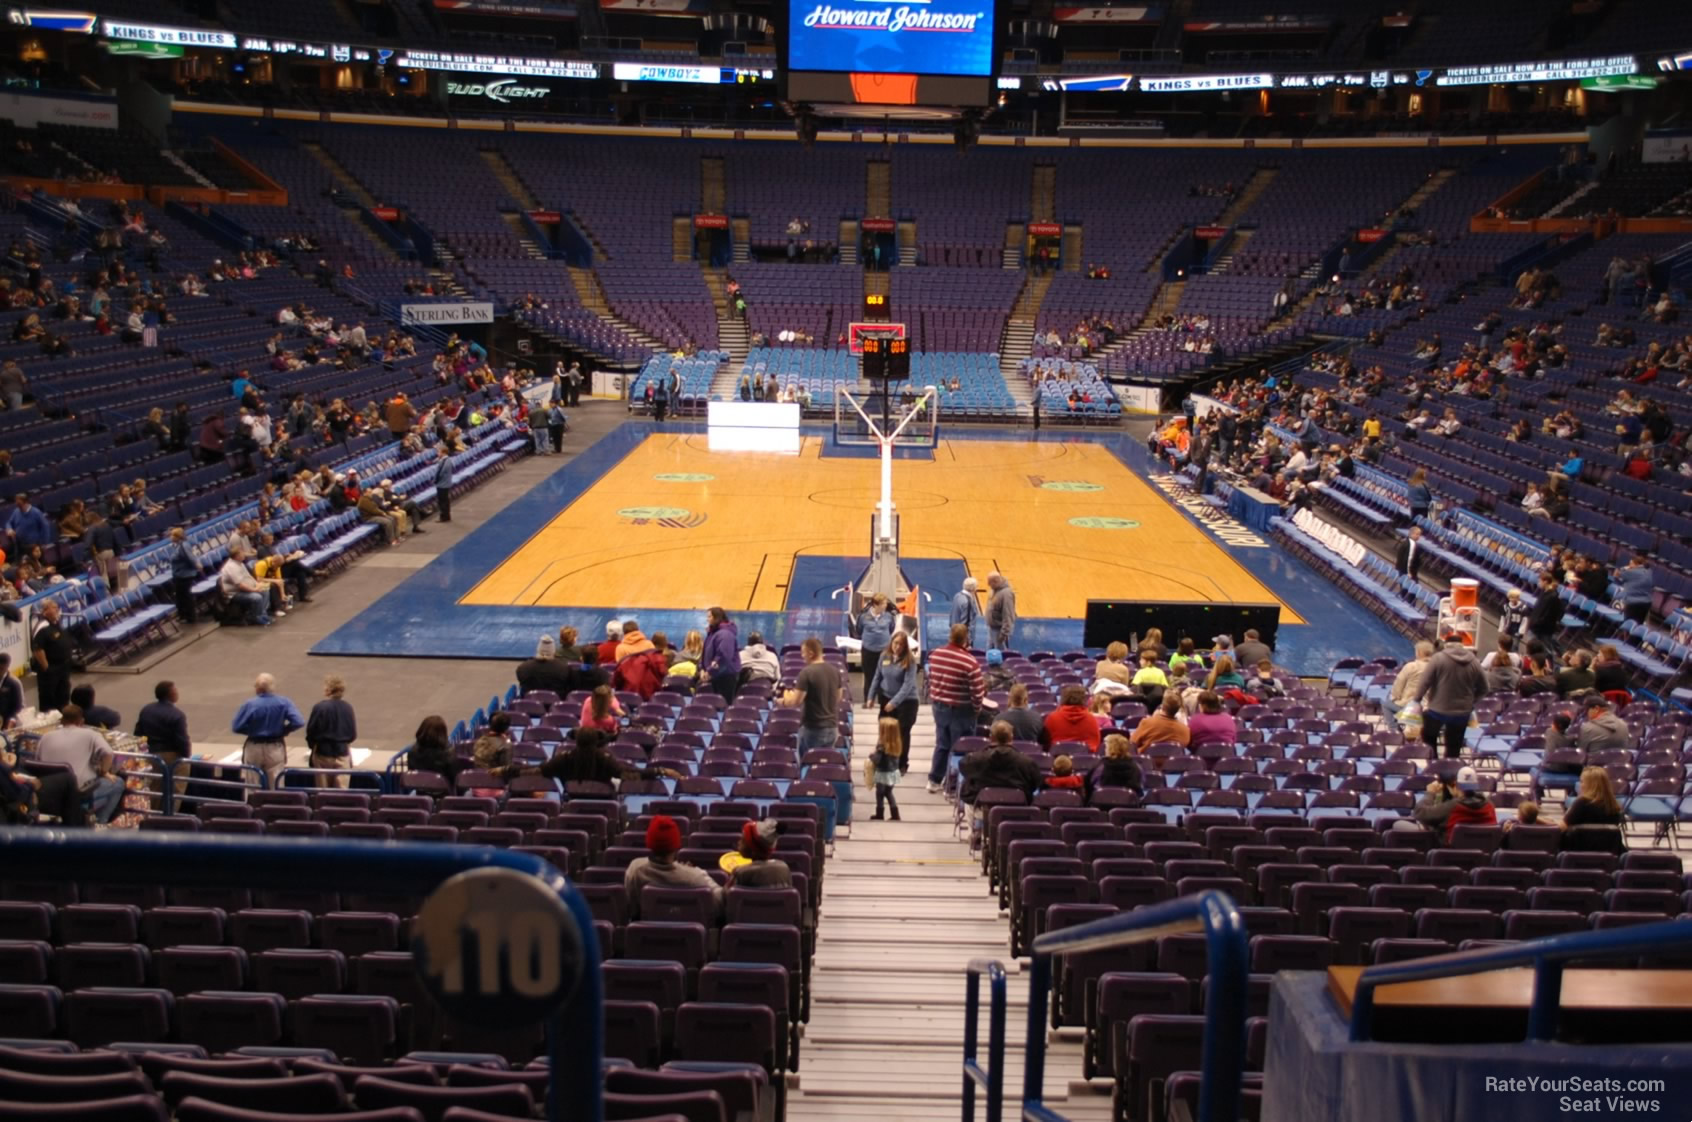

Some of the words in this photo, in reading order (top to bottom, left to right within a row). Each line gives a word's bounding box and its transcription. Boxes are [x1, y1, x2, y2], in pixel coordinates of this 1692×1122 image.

[804, 5, 891, 27] Howard
[888, 6, 977, 32] Johnson
[112, 27, 155, 39] KINGS
[178, 32, 225, 44] BLUES
[244, 38, 271, 51] JAN.
[406, 51, 438, 60] TICKETS
[454, 55, 473, 63] SALE
[498, 57, 507, 65] AT
[509, 58, 524, 66] THE
[567, 61, 593, 70] OFFICE
[1447, 67, 1478, 76] TICKETS
[1480, 66, 1491, 74] ON
[1494, 65, 1512, 73] SALE
[1515, 63, 1535, 72] NOW
[1537, 63, 1546, 71] AT
[1549, 61, 1563, 70] THE
[1567, 60, 1589, 68] FORD
[1591, 59, 1605, 67] BOX
[1608, 57, 1633, 66] OFFICE
[639, 67, 701, 80] COWBOYZ
[1546, 70, 1567, 79] CALL
[1148, 80, 1192, 90] KINGS
[1217, 76, 1261, 87] BLUES
[1281, 76, 1308, 87] JAN.
[447, 82, 485, 96] BUD
[495, 85, 550, 98] LIGHT
[406, 306, 459, 321] STERLING
[462, 306, 489, 319] BANK
[434, 910, 561, 998] 110
